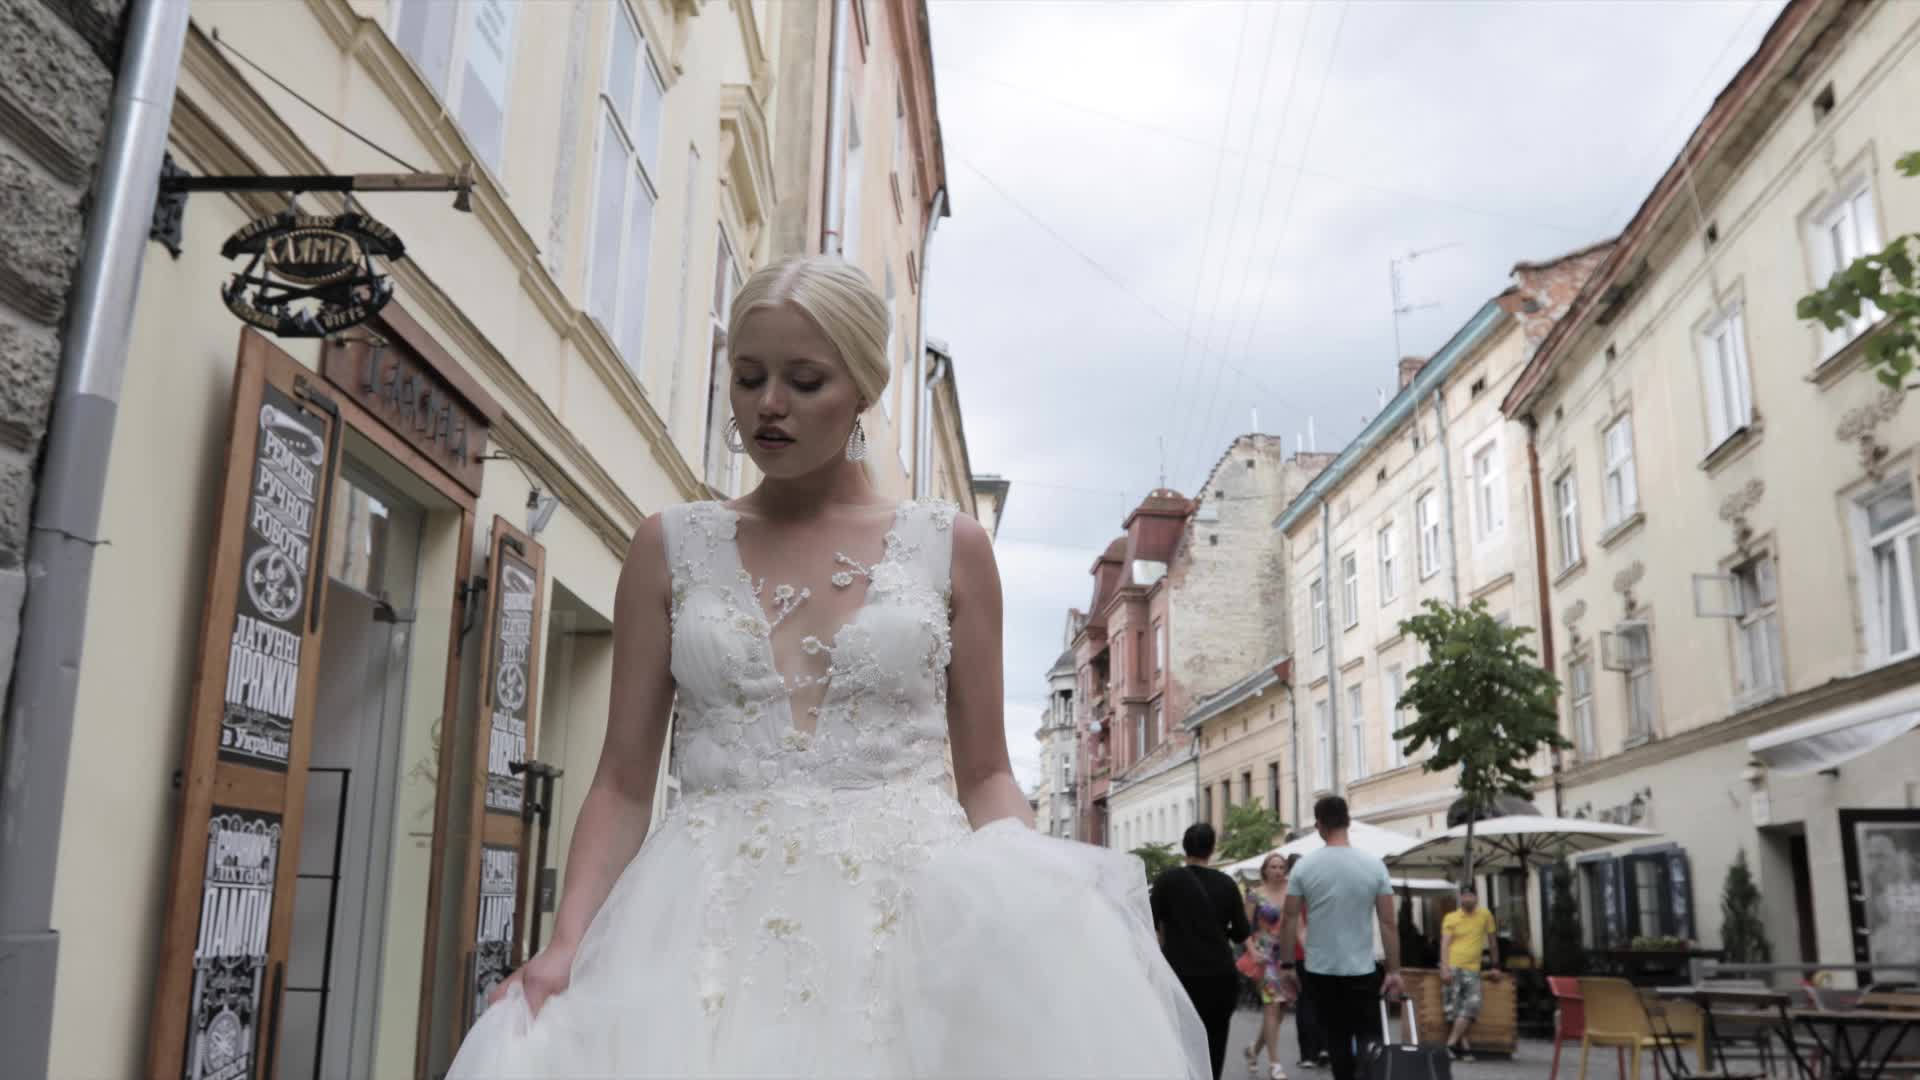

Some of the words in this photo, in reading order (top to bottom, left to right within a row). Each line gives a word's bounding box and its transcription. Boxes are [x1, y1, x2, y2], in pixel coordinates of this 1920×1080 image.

[264, 428, 315, 497] РЕМЕНІ
[252, 501, 309, 578] РОБОТИ
[233, 614, 301, 666] ЛАТУННІ
[225, 644, 298, 720] ПРЯЖКИ
[194, 886, 273, 959] ЛАМПИ
